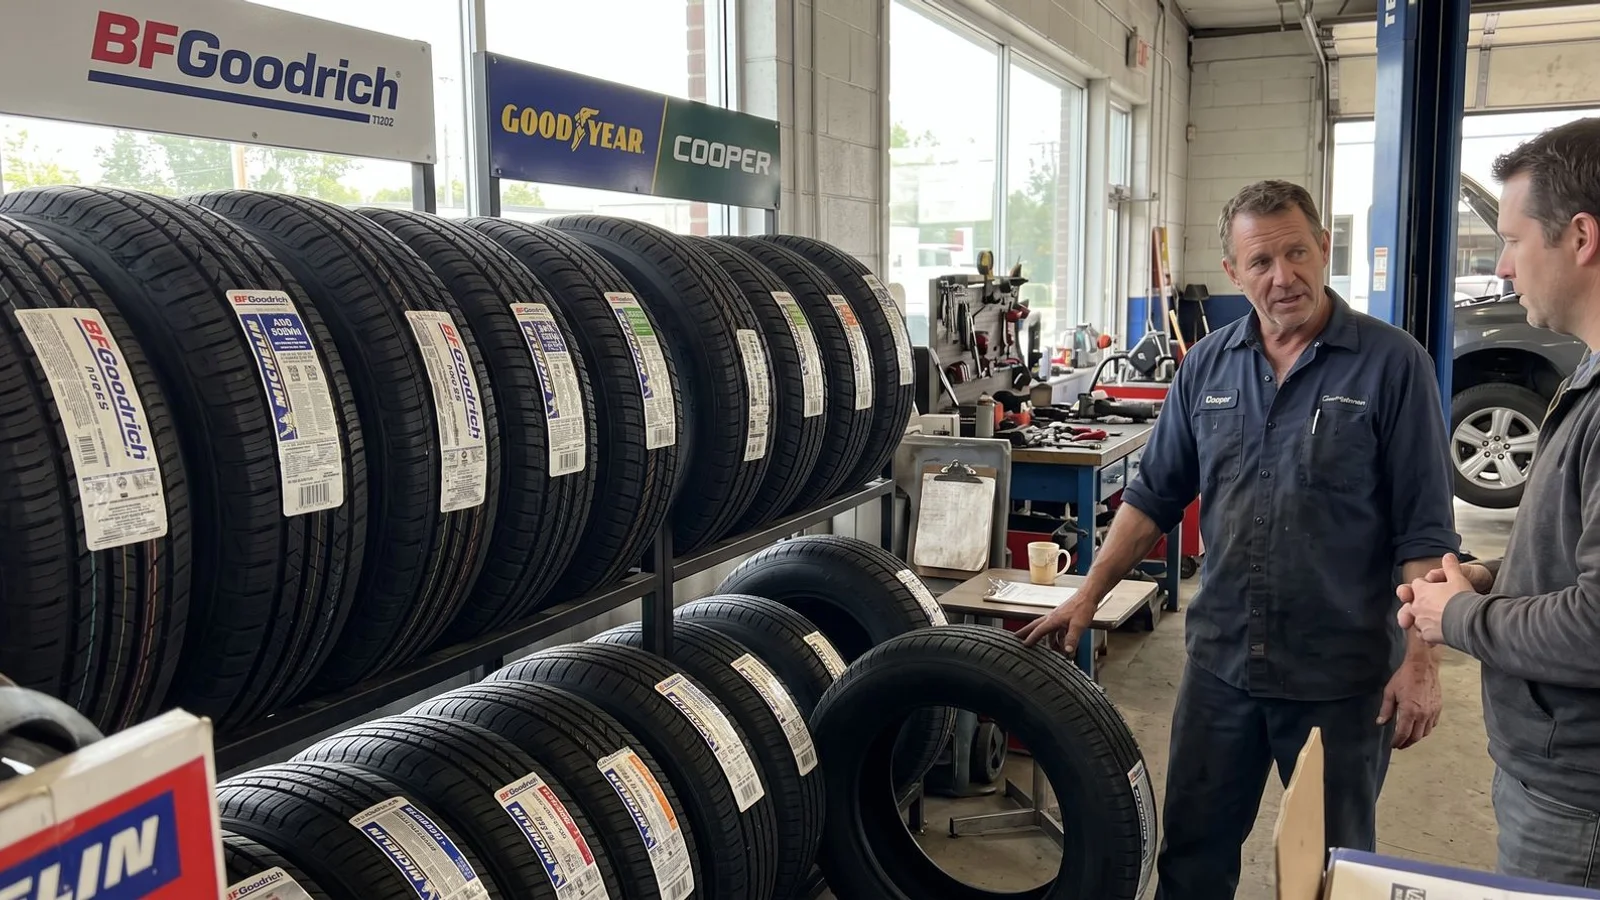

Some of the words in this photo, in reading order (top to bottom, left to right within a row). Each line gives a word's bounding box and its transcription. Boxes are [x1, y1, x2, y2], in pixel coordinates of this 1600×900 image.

[91, 10, 399, 110] BFGoodrich
[673, 134, 771, 176] COOPER
[234, 295, 289, 304] BFGoodrich
[80, 318, 149, 461] BFGoodrich
[246, 319, 288, 408] MICHELIN
[441, 322, 480, 440] BFGoodrich
[1205, 395, 1232, 405] Cooper
[367, 827, 424, 882] MICHELIN
[511, 807, 555, 864] MICHELIN
